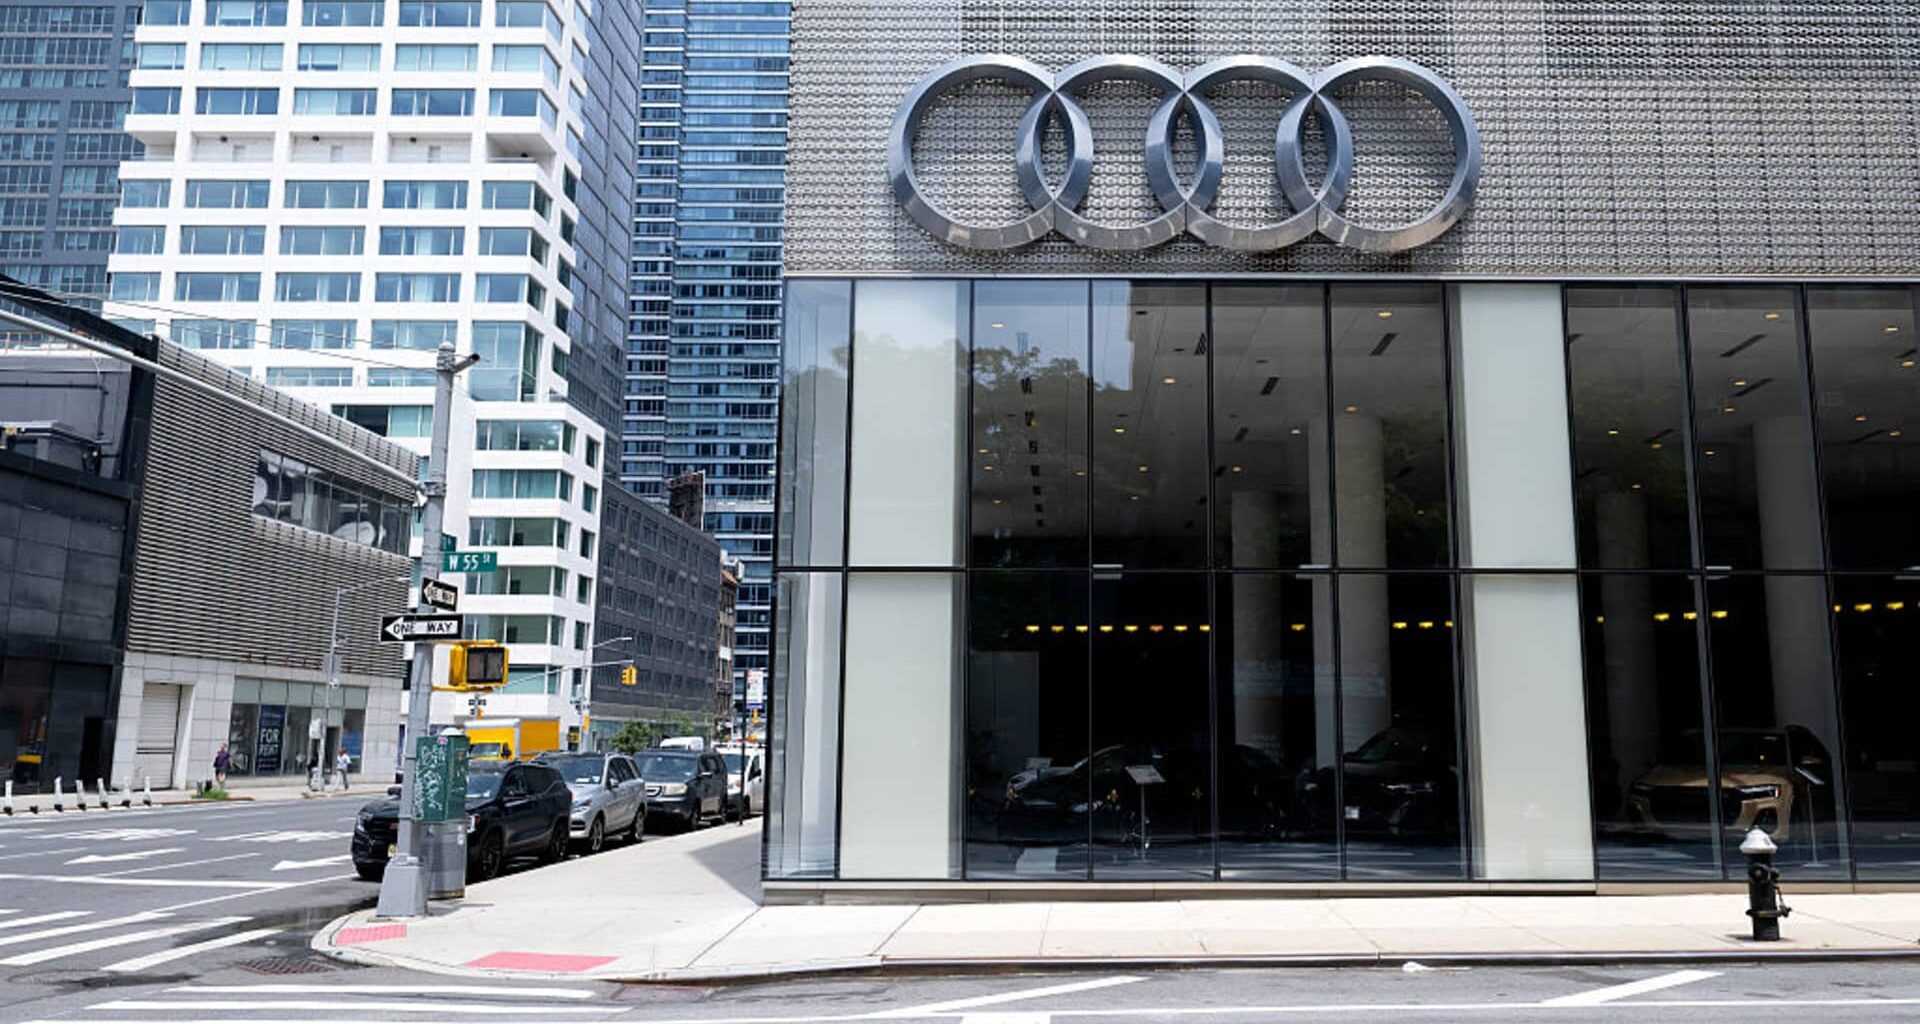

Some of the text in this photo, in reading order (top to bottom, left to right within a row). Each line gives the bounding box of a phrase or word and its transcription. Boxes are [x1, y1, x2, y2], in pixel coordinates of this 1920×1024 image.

[449, 555, 458, 571] W
[463, 554, 479, 571] 55
[393, 622, 453, 634] ONE WAY
[260, 728, 280, 743] FOR
[259, 744, 279, 756] RENT
